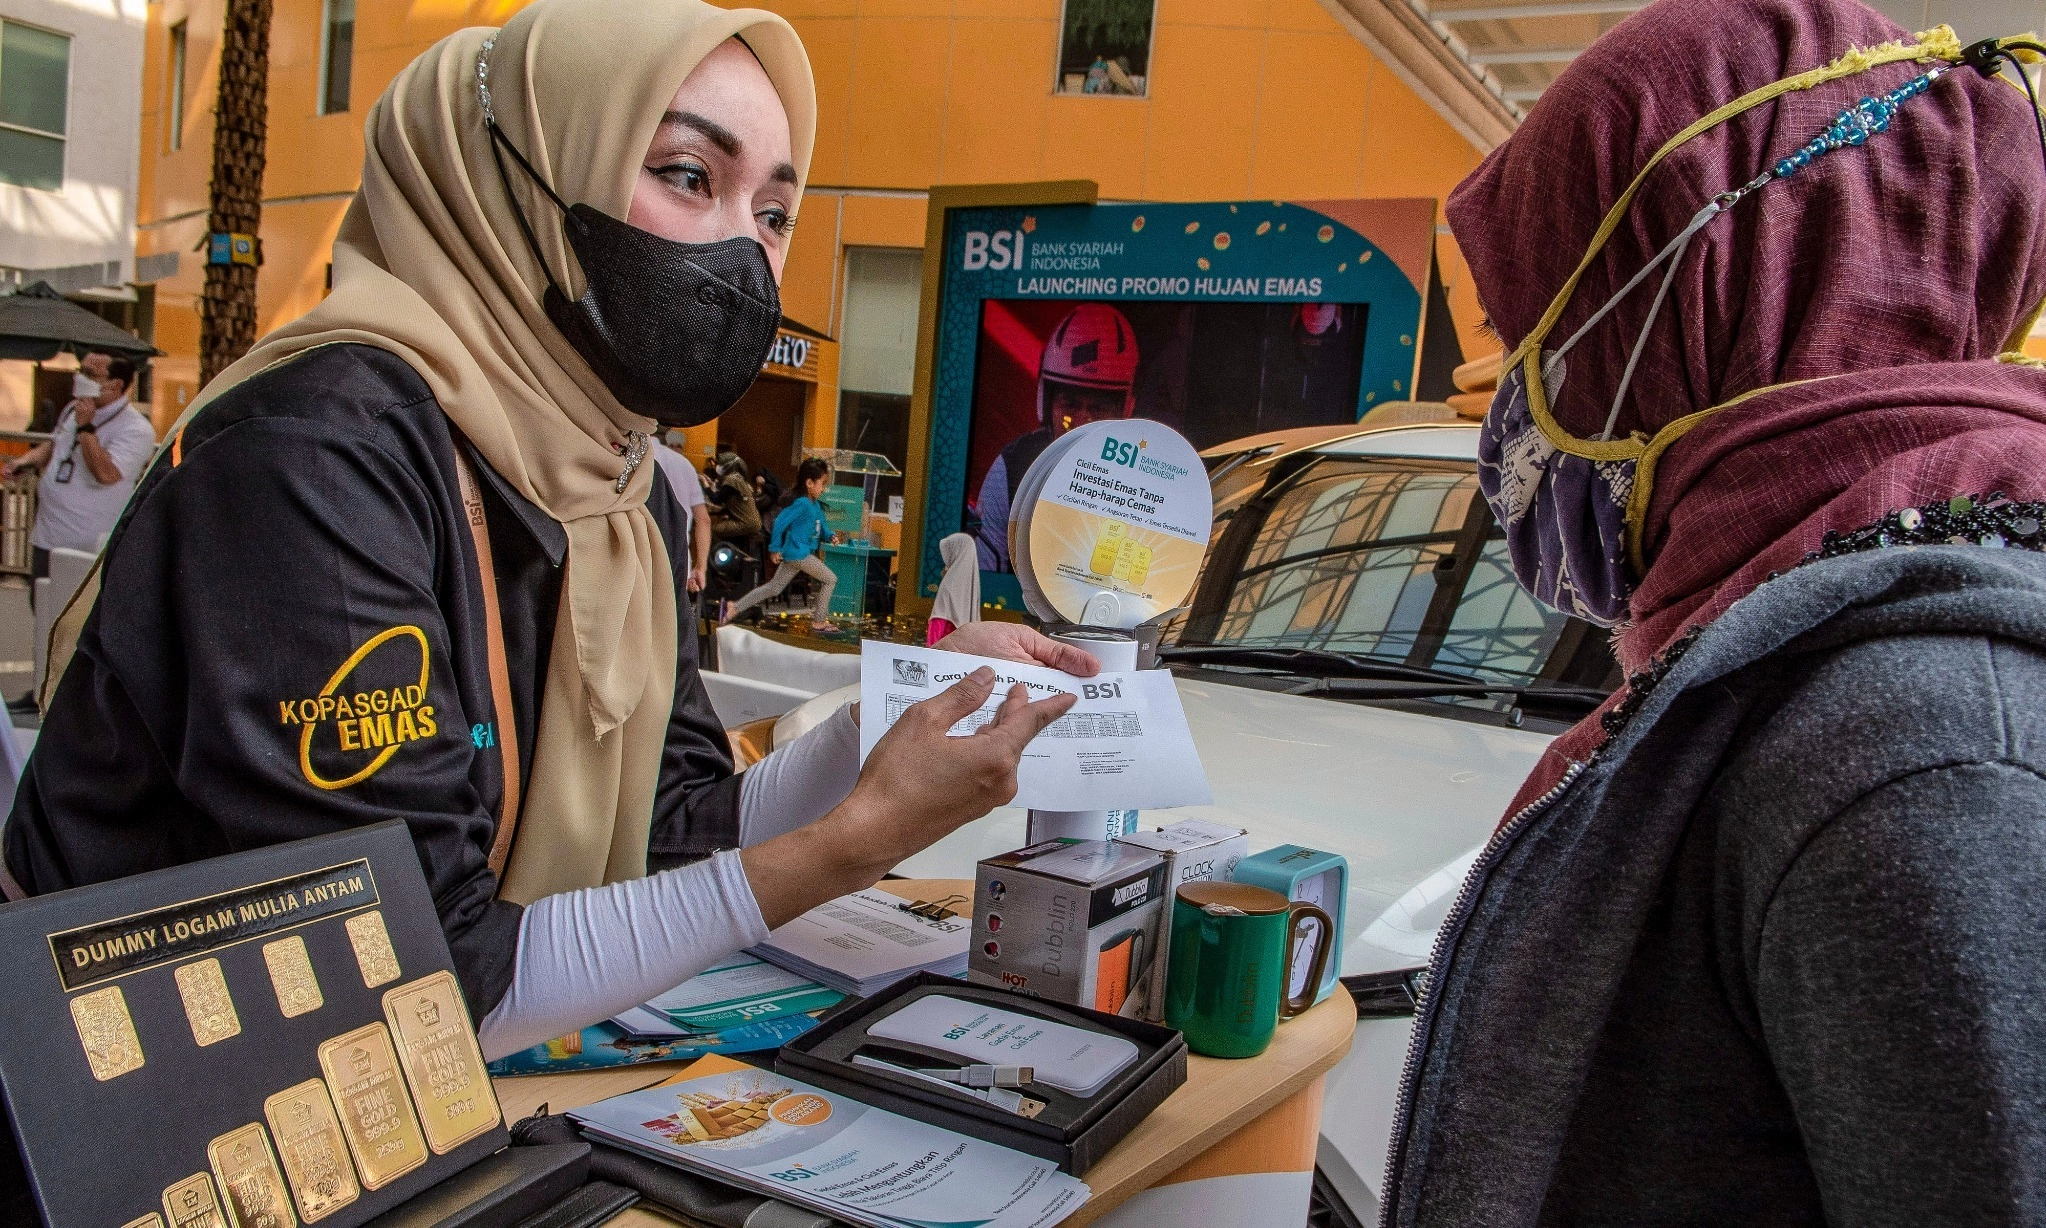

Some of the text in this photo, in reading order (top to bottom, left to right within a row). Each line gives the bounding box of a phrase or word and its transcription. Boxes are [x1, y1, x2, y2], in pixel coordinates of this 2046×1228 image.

[963, 230, 1025, 271] BSI
[1031, 241, 1124, 256] BANK SYARIAH
[1030, 257, 1101, 271] INDONESIA
[1017, 277, 1323, 297] LAUNCHING PROMO HUJAN EMAS
[1100, 436, 1139, 469] BSI
[1076, 458, 1109, 475] Cicil Emas
[1138, 464, 1175, 481] INDONESIA
[1140, 456, 1189, 477] BANK SYARIAH
[1069, 480, 1156, 515] Harap-harap Cemas
[1073, 468, 1165, 504] Investasi Emas Tanpa
[469, 502, 484, 526] BSI
[933, 671, 962, 683] Cara
[1081, 682, 1122, 700] BSI
[279, 685, 424, 725] KOPASGAD
[337, 706, 438, 751] EMAS
[1181, 859, 1215, 880] CLOCK
[72, 875, 365, 968] DUMMY LOGAM MULIA ANTAM
[927, 921, 965, 934] BSI
[1042, 894, 1068, 977] Dubblin
[1002, 971, 1028, 988] HOT
[736, 1002, 782, 1018] BSI
[943, 1026, 971, 1041] BSI
[421, 1040, 463, 1075] FINE
[428, 1060, 467, 1088] GOLD
[433, 1073, 471, 1102] 999.9
[354, 1086, 393, 1116] FINE
[360, 1103, 397, 1129] GOLD
[364, 1116, 401, 1142] 999.9
[946, 1142, 968, 1163] Ringan
[768, 1166, 820, 1182] BSI
[861, 1150, 940, 1194] Menguntungkan
